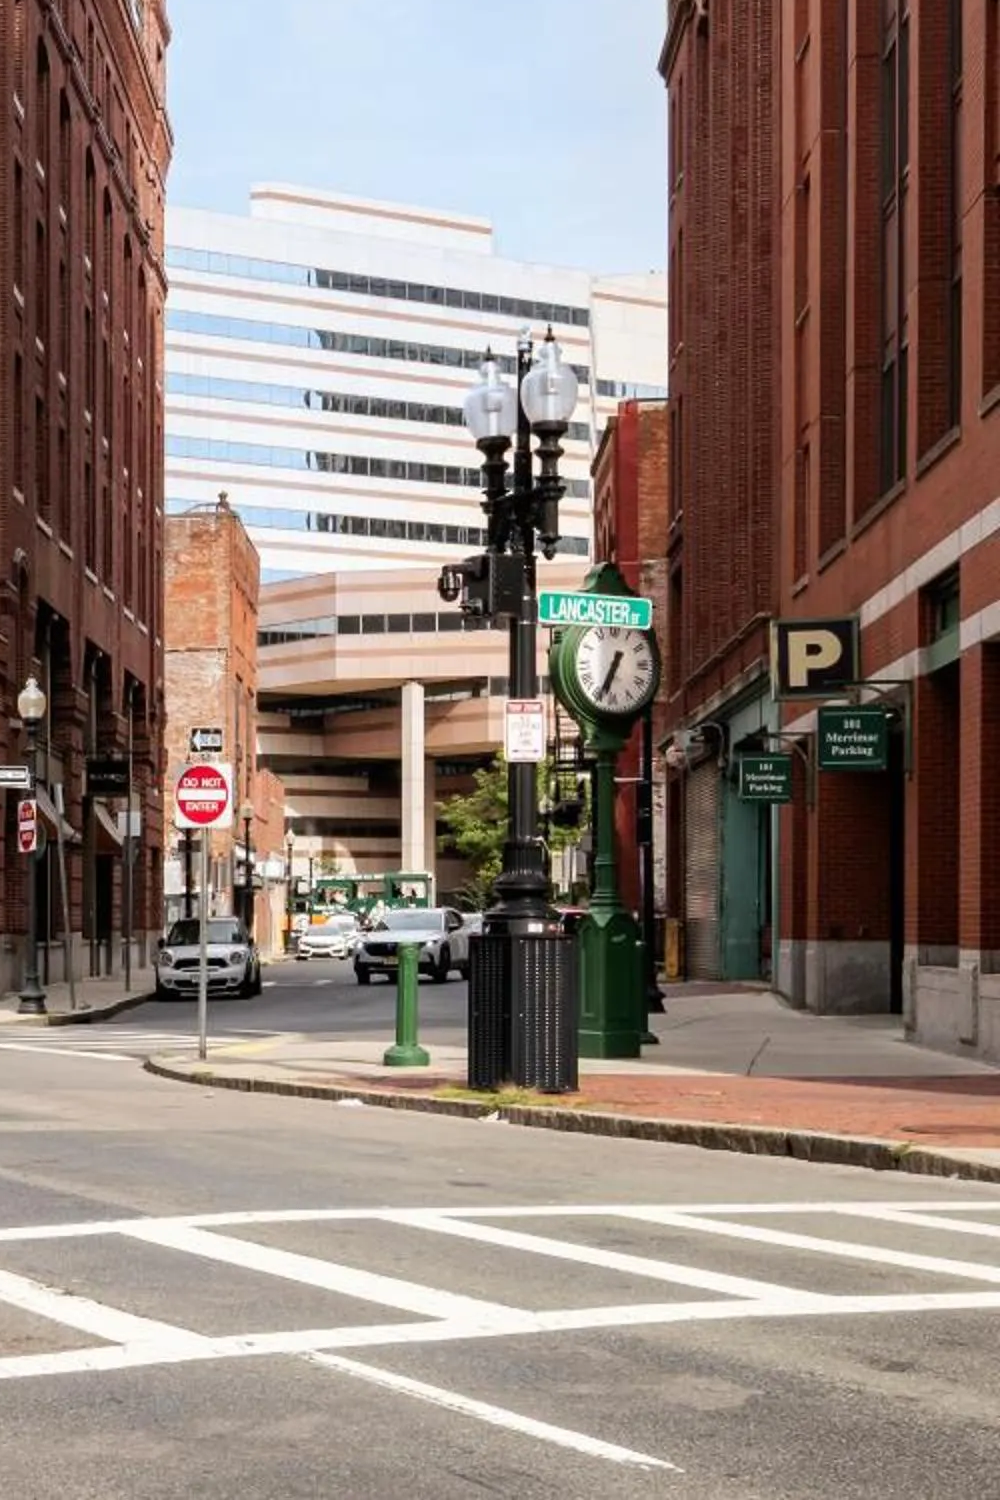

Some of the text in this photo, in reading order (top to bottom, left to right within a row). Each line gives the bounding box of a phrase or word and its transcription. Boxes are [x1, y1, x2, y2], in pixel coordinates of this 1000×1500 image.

[550, 597, 630, 623] LANCASTER
[788, 629, 842, 687] P
[831, 745, 873, 757] Parking
[183, 777, 222, 788] DO NOT
[185, 801, 219, 813] ENTER
